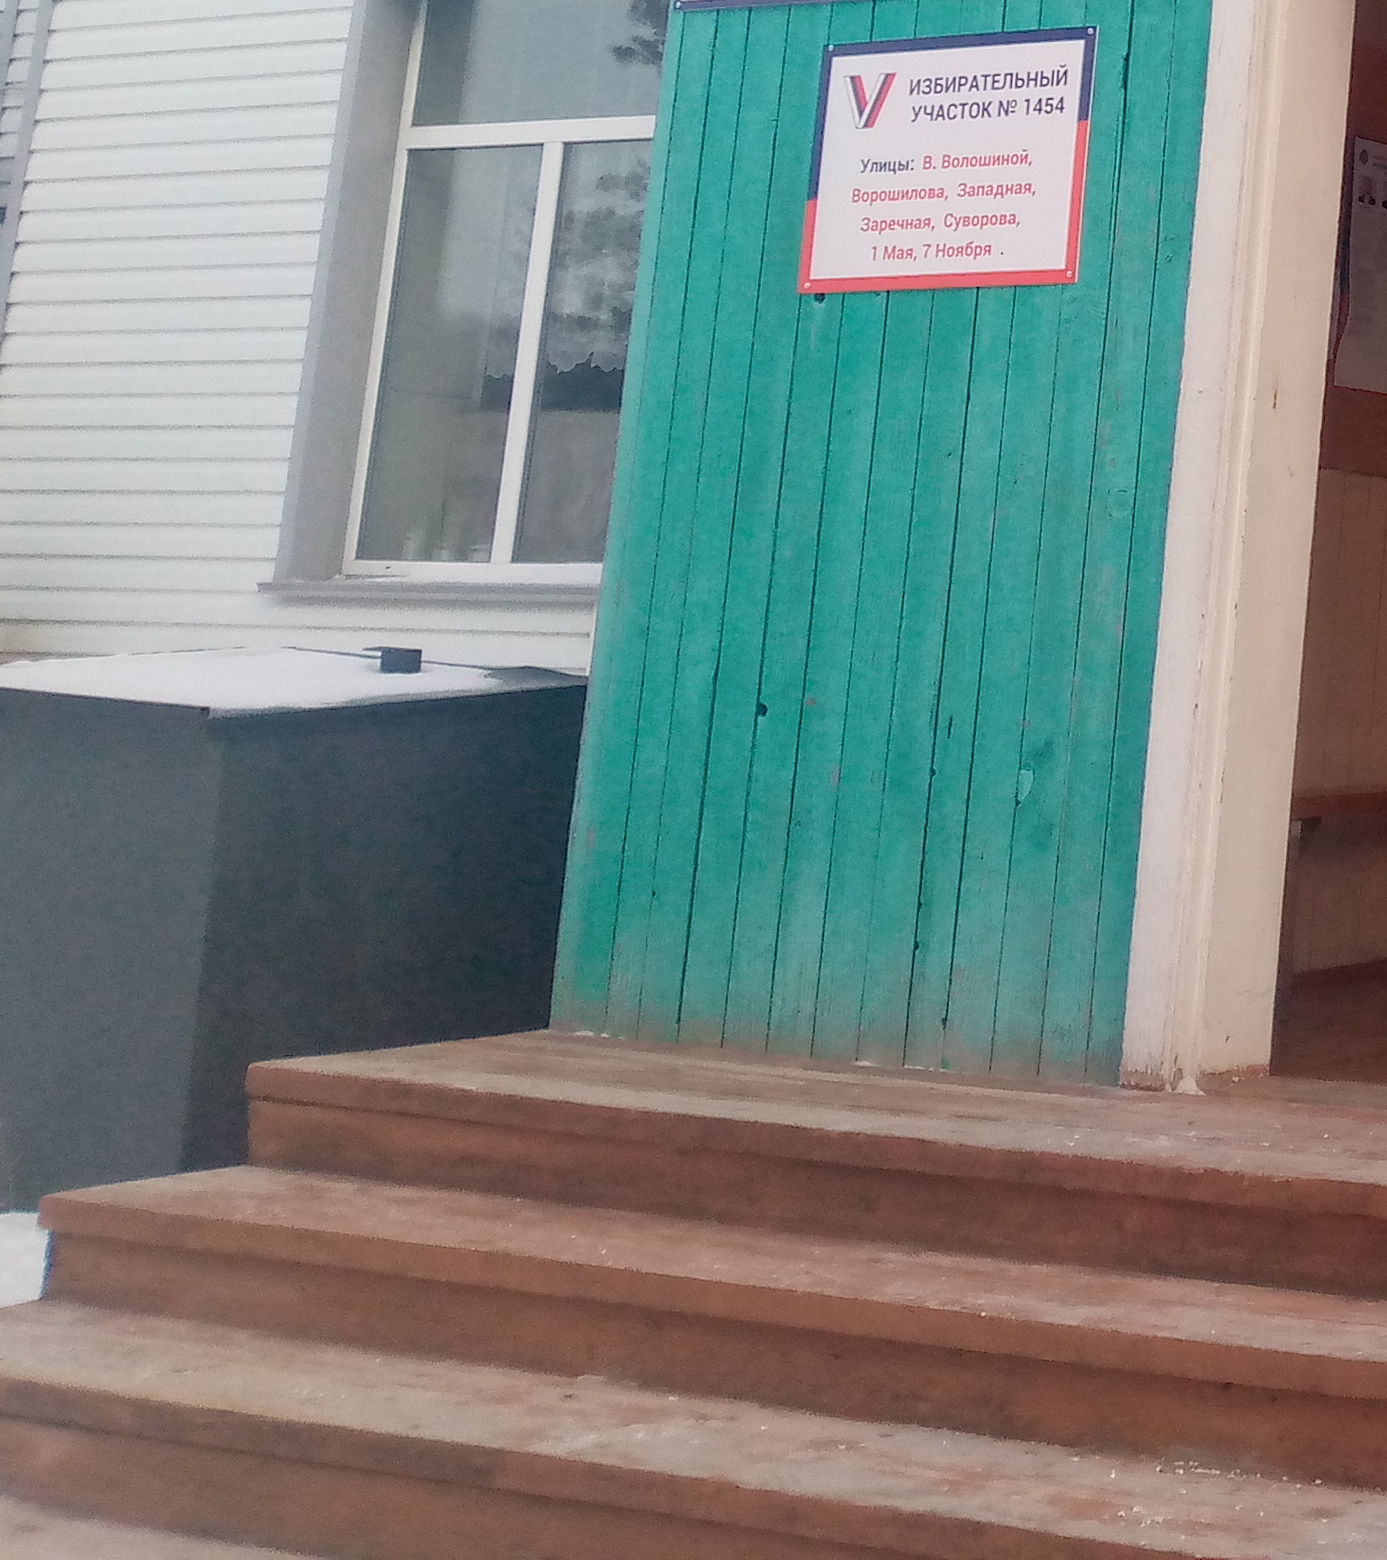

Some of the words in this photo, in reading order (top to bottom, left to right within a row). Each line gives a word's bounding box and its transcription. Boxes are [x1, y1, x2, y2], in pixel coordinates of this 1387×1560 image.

[909, 64, 1068, 96] ИЗБИРАТЕЛЬНЫЙ
[911, 100, 993, 123] УЧАСТОК
[997, 98, 1018, 117] №
[1023, 96, 1065, 116] 1454
[860, 157, 915, 176] Улицы:
[922, 155, 937, 171] В.
[941, 149, 1033, 170] Волошиной,
[851, 186, 949, 207] Ворошилова,
[957, 180, 1037, 199] Западная,
[860, 217, 936, 236] Заречная,
[943, 212, 1021, 231] Суворова,
[870, 246, 877, 261] 1
[882, 245, 918, 262] Мая,
[922, 243, 931, 260] 7
[935, 241, 992, 261] Ноября
